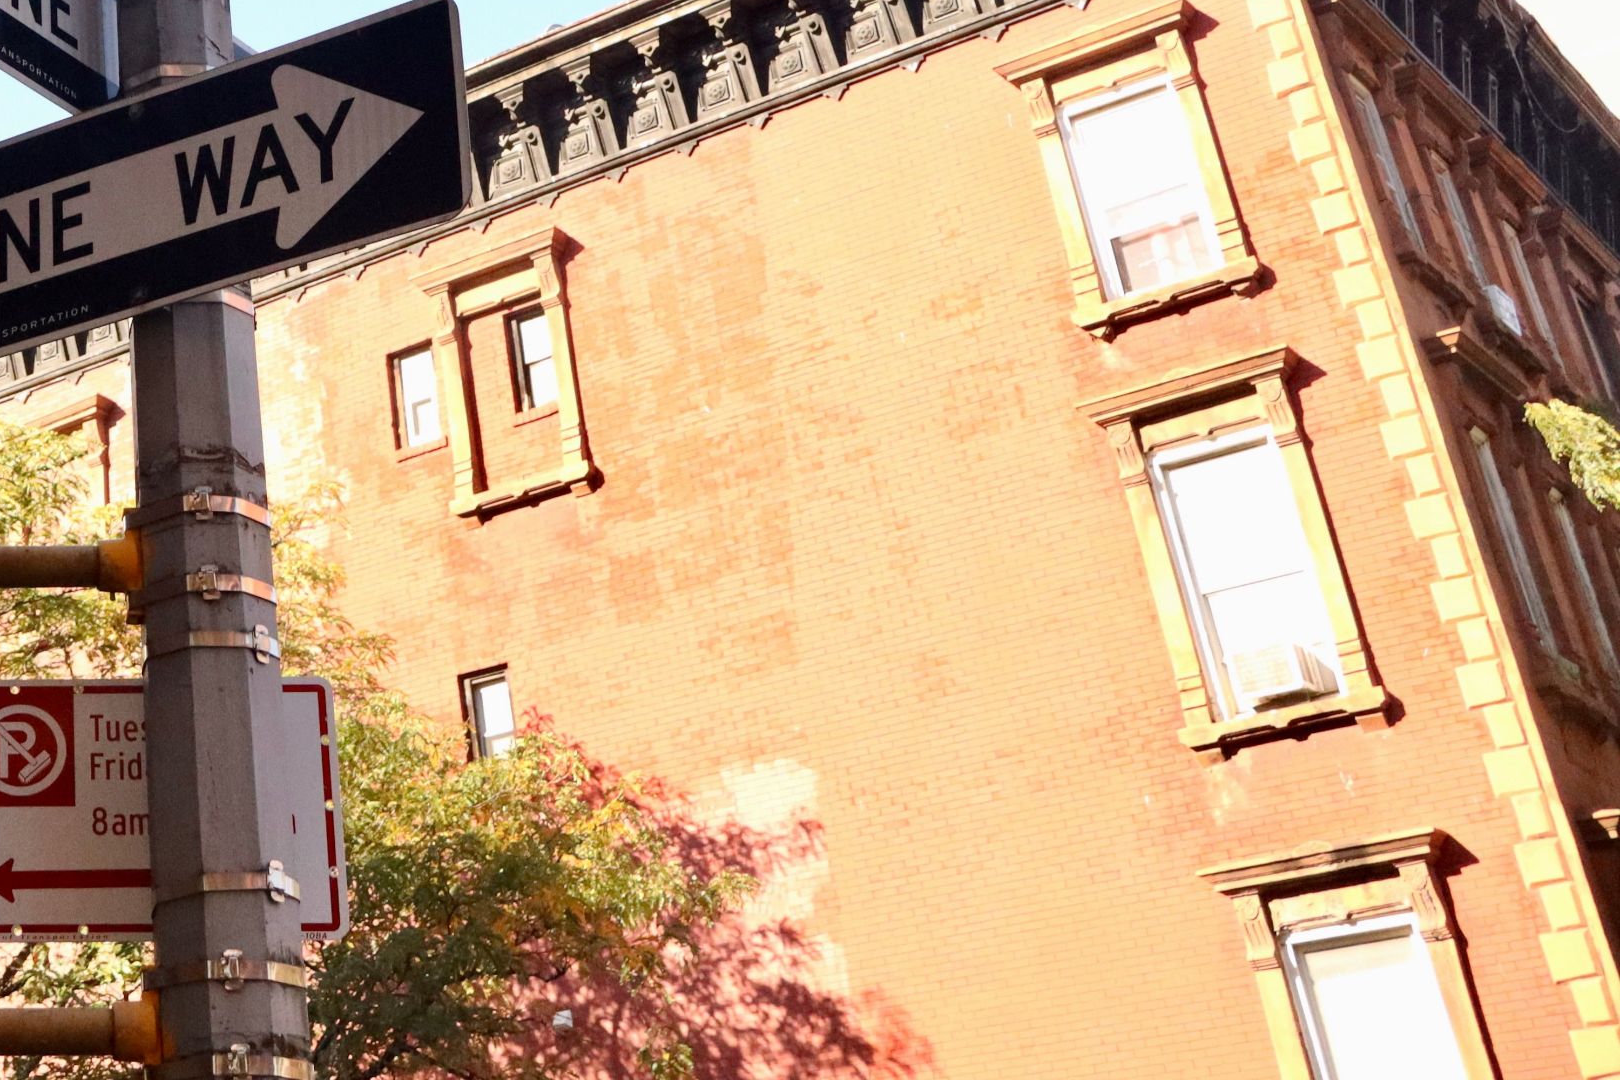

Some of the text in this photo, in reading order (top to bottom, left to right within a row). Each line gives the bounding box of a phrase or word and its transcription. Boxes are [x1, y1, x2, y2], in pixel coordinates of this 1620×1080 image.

[174, 97, 355, 226] WAY
[90, 752, 142, 780] Frid
[300, 932, 328, 940] -108A
